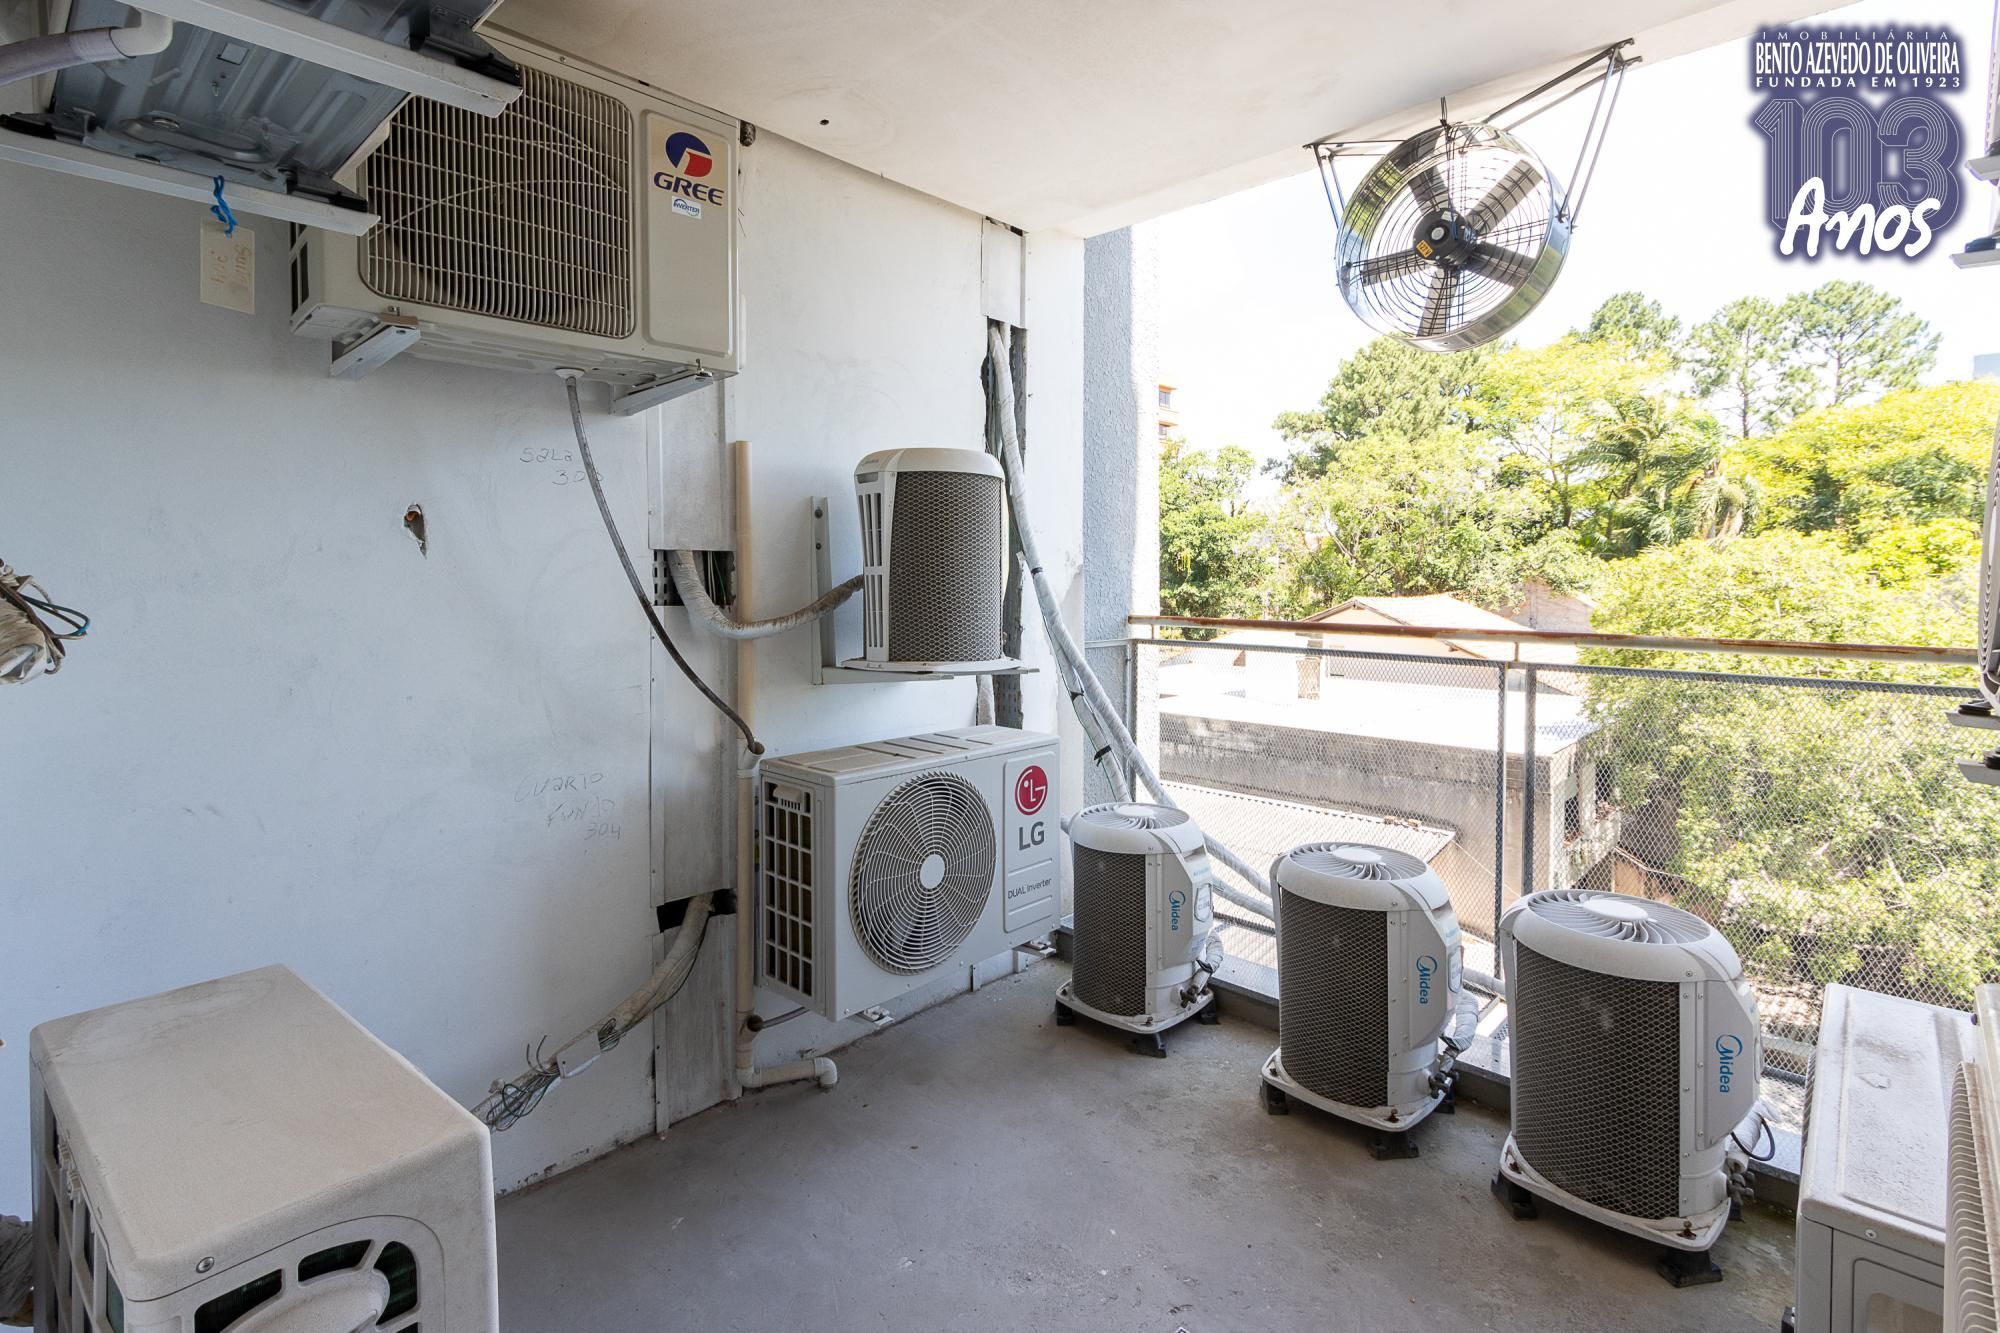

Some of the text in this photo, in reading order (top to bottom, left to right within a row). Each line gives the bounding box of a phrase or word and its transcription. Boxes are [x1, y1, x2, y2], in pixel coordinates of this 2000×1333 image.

[653, 171, 725, 207] GREE
[1018, 821, 1046, 851] LG
[1007, 878, 1052, 899] DUAL Inverter
[1170, 894, 1182, 931] Midea
[1417, 959, 1434, 1005] Midea
[1718, 1039, 1738, 1093] Midea
